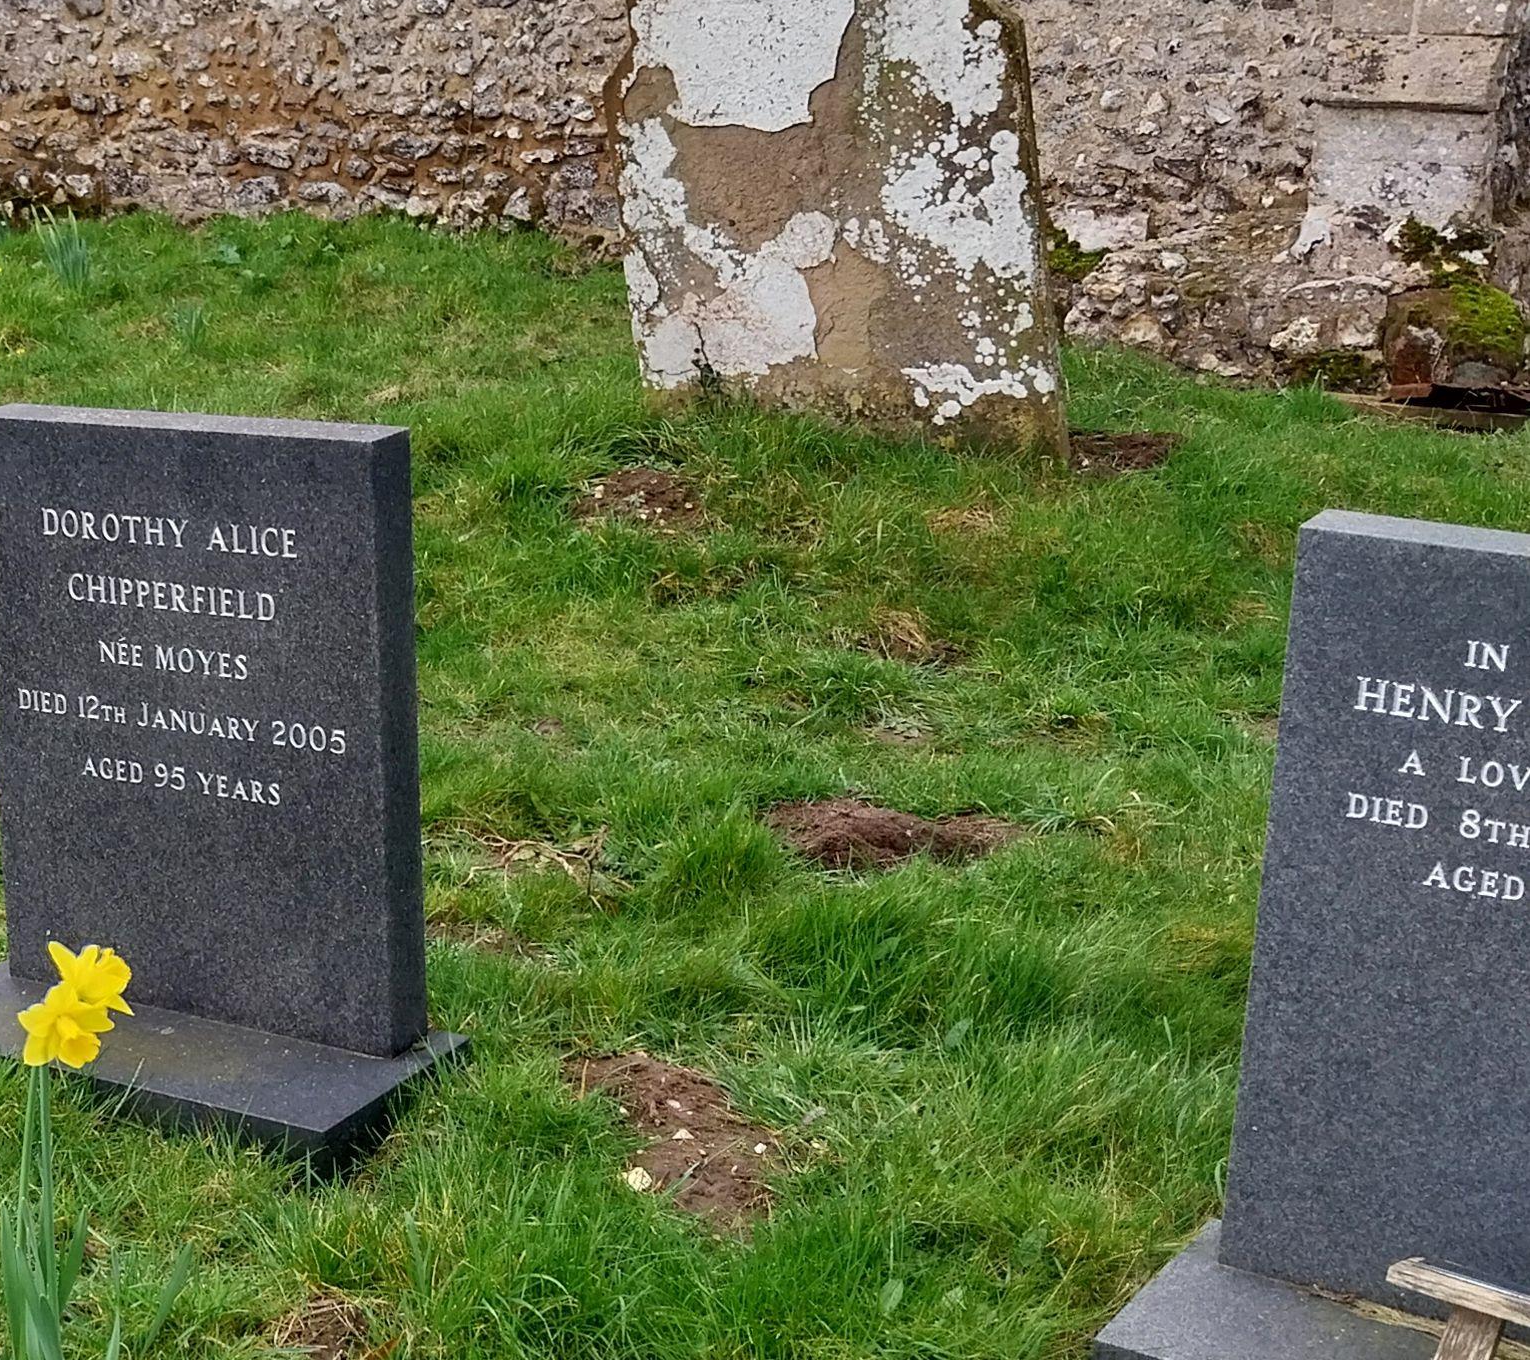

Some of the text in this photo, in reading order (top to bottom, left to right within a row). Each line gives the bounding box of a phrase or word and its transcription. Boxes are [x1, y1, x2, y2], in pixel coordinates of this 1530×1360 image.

[41, 507, 298, 559] DOROTHY ALICE
[68, 572, 275, 621] CHIPPERFIELD
[98, 636, 248, 680] NÉE MOYES
[1464, 640, 1510, 672] IN
[18, 687, 346, 755] DIED 12TH JANUARY 2005
[1354, 676, 1522, 732] HENRY
[82, 757, 281, 806] AGED 95 YEARS
[1398, 750, 1426, 777] A
[1346, 792, 1530, 849] DIED 8TH
[1422, 862, 1525, 901] AGED
